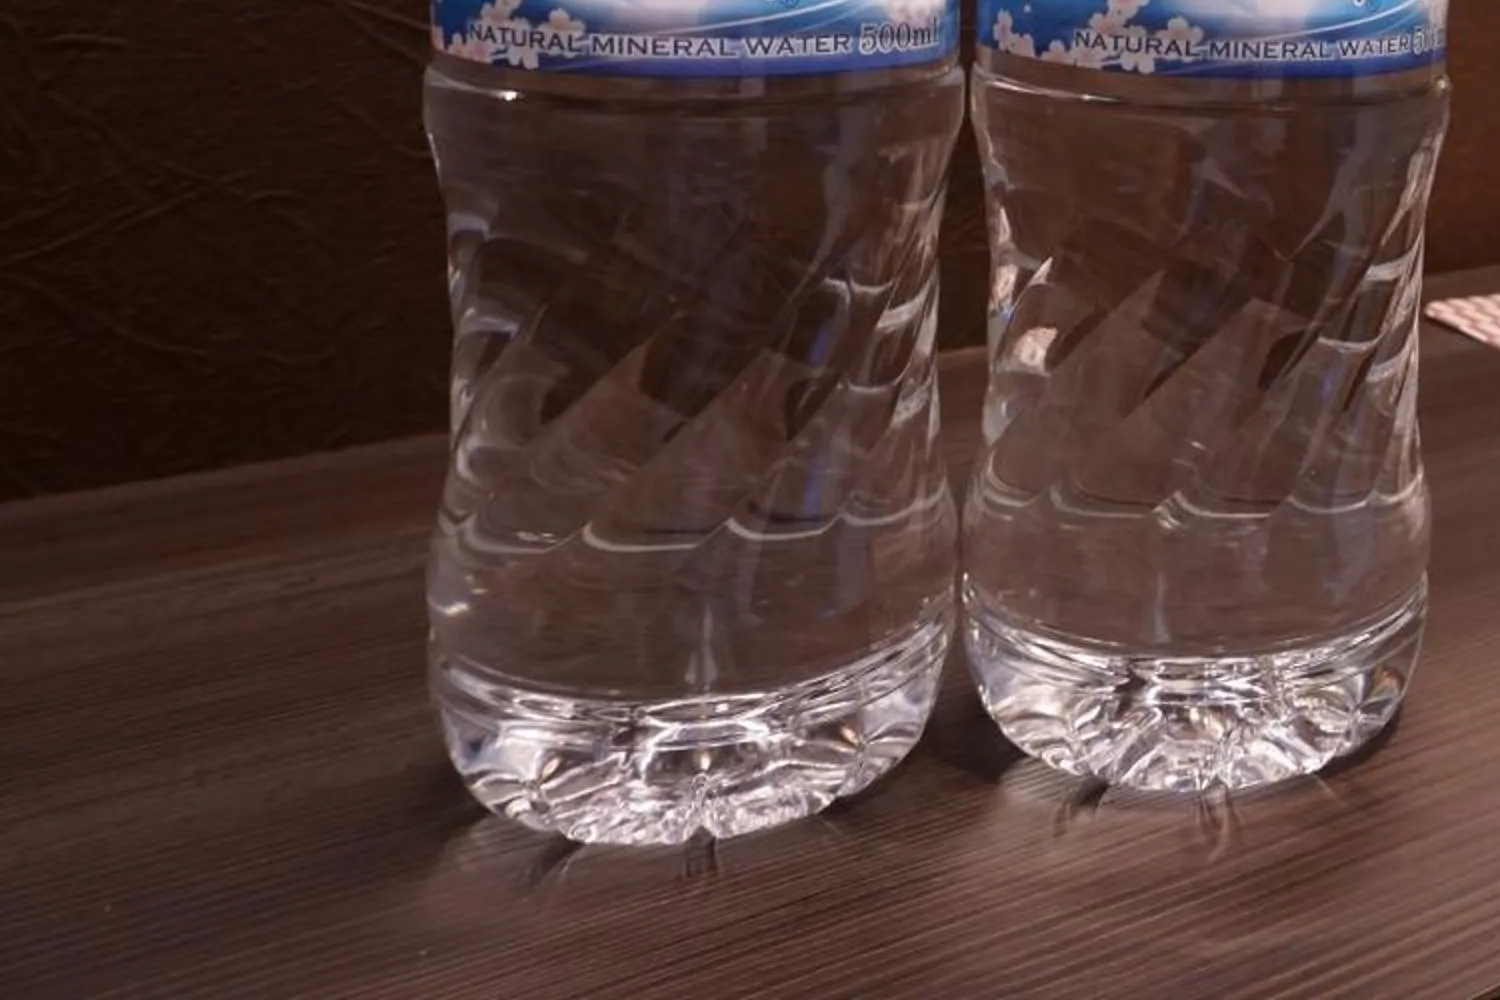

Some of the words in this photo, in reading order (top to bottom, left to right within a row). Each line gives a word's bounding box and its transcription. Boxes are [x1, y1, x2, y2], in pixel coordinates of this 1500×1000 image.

[468, 24, 578, 53] NATURAL
[592, 35, 739, 58] MINERAL
[747, 33, 850, 56] WATER
[861, 16, 938, 51] 500ml
[1075, 31, 1198, 57] NATURAL
[1207, 38, 1331, 59] MINERAL
[1338, 34, 1409, 56] WATER
